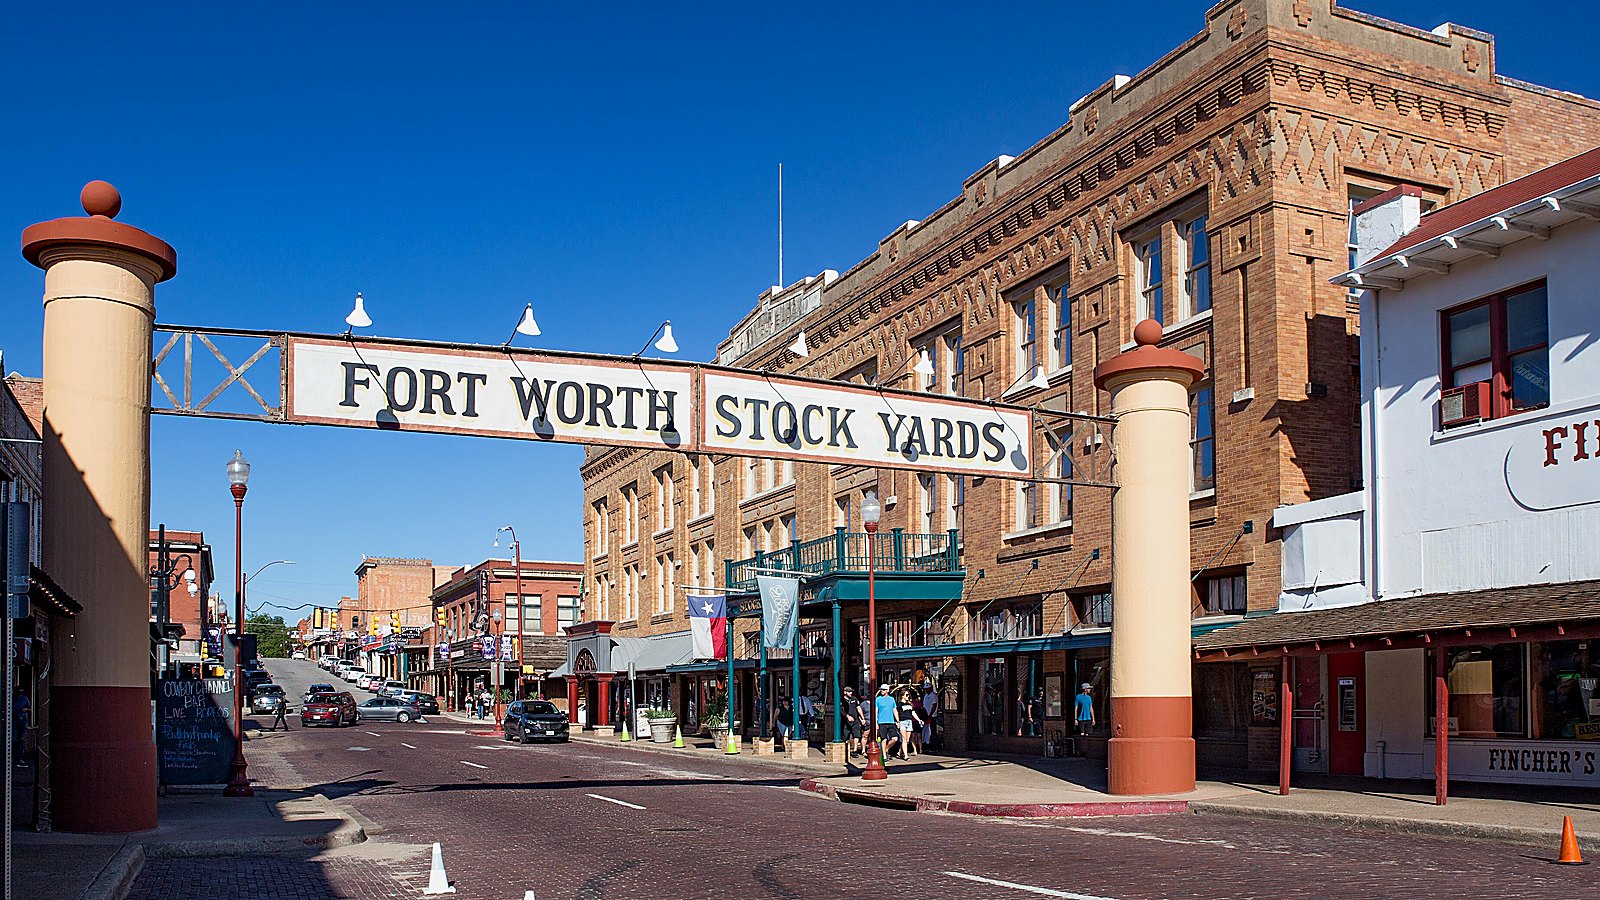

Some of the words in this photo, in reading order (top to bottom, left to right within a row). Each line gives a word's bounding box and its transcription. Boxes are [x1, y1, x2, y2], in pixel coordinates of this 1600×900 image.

[339, 361, 487, 418] FORT
[510, 376, 678, 432] WORTH
[715, 394, 859, 449] STOCK
[877, 411, 1006, 463] YARDS
[164, 681, 195, 697] COWBOY
[196, 680, 233, 694] CHANNEL
[184, 695, 206, 708] BAR
[165, 707, 186, 719] LIVE
[1488, 748, 1595, 774] FINCHER'S
